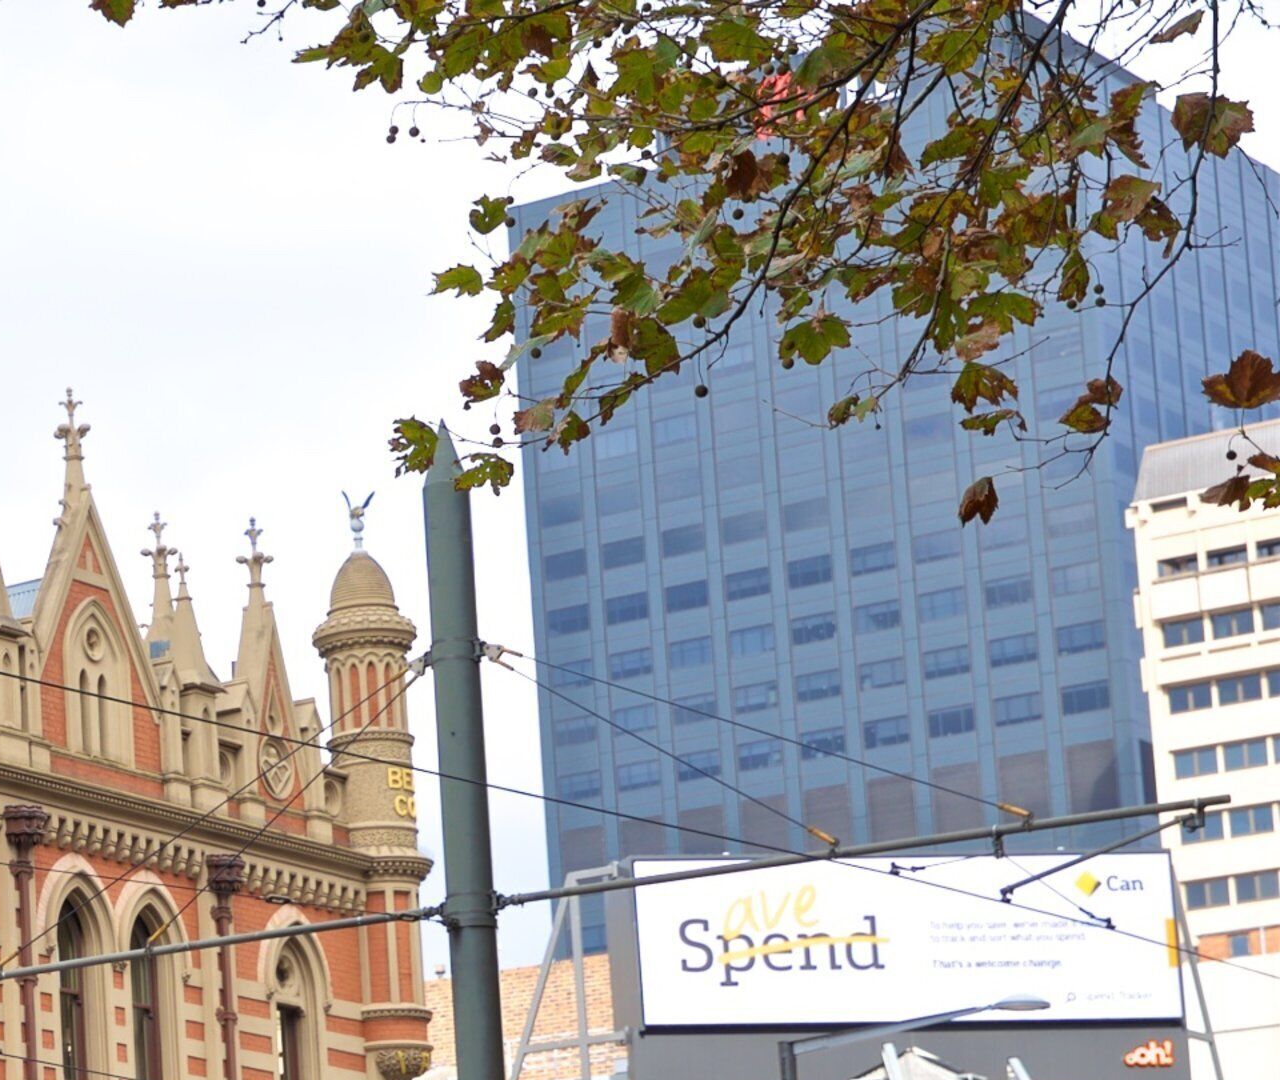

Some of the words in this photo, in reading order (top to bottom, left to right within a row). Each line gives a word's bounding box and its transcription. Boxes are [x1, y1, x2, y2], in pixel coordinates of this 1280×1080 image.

[1106, 875, 1143, 893] Can
[678, 915, 885, 987] Spend
[932, 959, 963, 969] That's
[976, 960, 1020, 968] welcome
